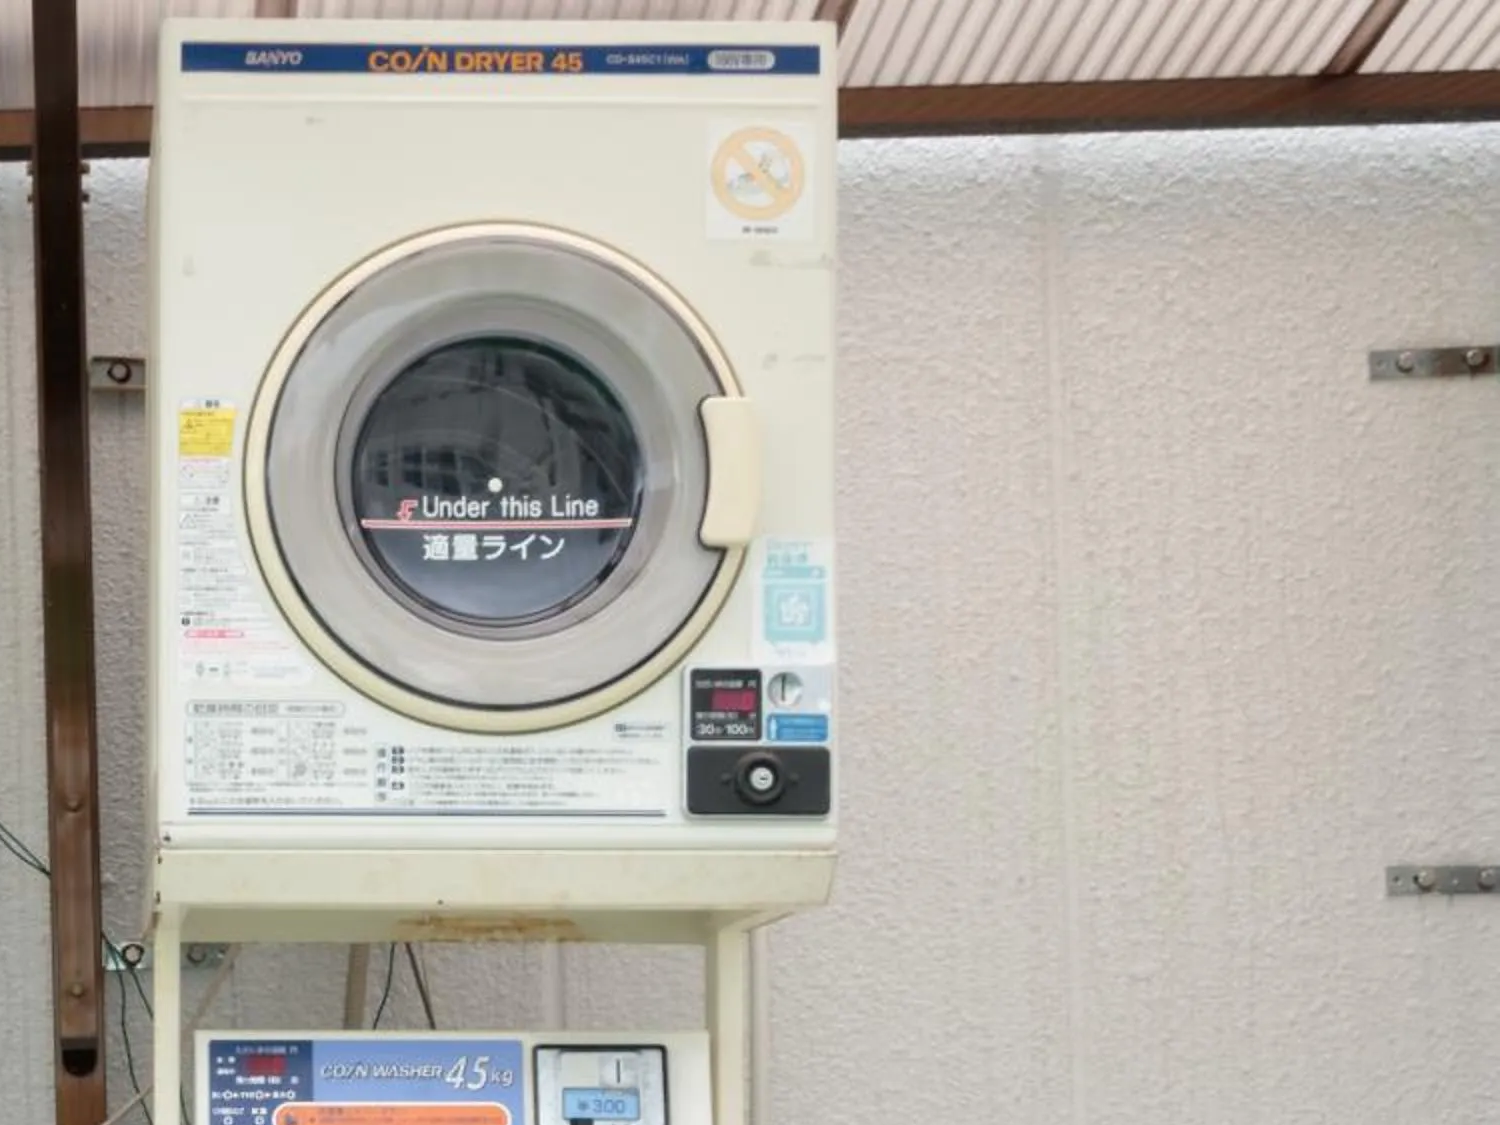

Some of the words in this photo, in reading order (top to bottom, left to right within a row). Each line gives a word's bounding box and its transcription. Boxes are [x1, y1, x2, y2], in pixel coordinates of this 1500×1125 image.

[245, 50, 302, 65] SANYO
[455, 51, 544, 72] DRYER
[552, 52, 583, 72] 45
[422, 495, 490, 517] Under
[500, 496, 542, 517] this
[551, 494, 599, 516] Line
[422, 533, 565, 560] 適量ライン
[372, 1064, 443, 1078] WASHER
[491, 1068, 513, 1087] kg
